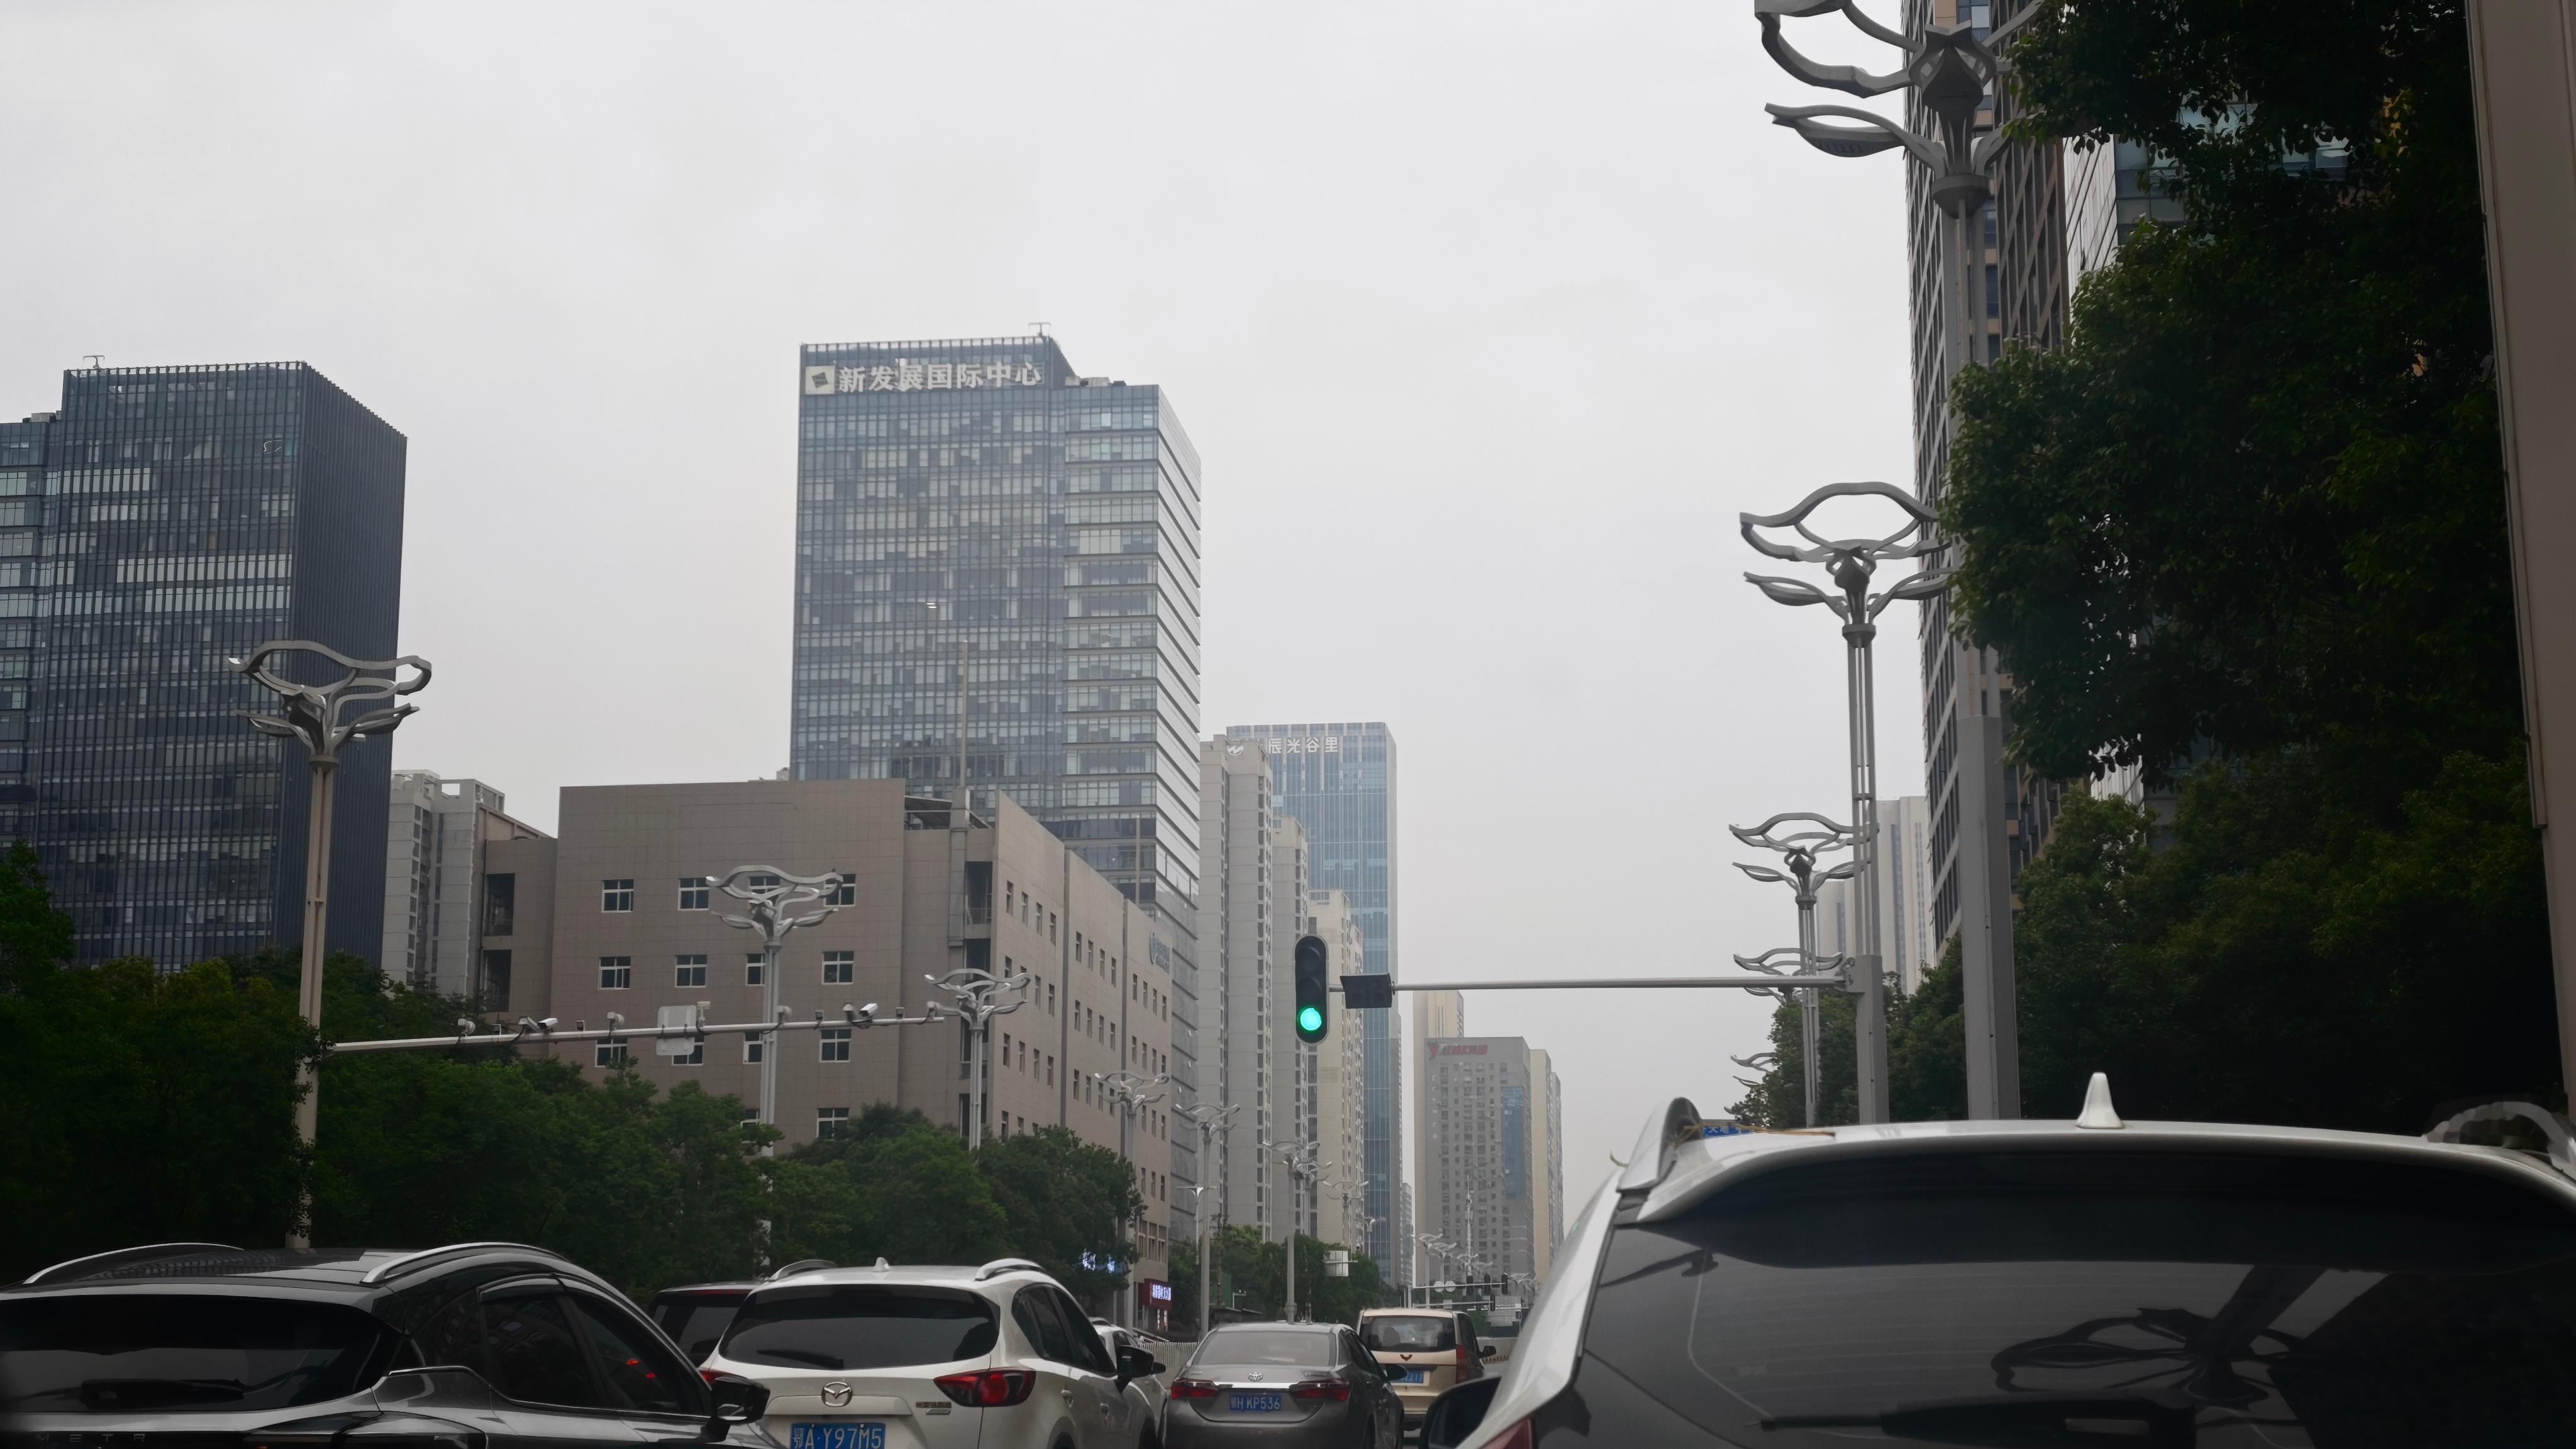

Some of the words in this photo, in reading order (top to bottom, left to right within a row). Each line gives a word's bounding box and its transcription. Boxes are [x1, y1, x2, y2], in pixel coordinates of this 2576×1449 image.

[838, 362, 1041, 392] 新发展国际中心
[1254, 737, 1338, 754] 辰光谷里
